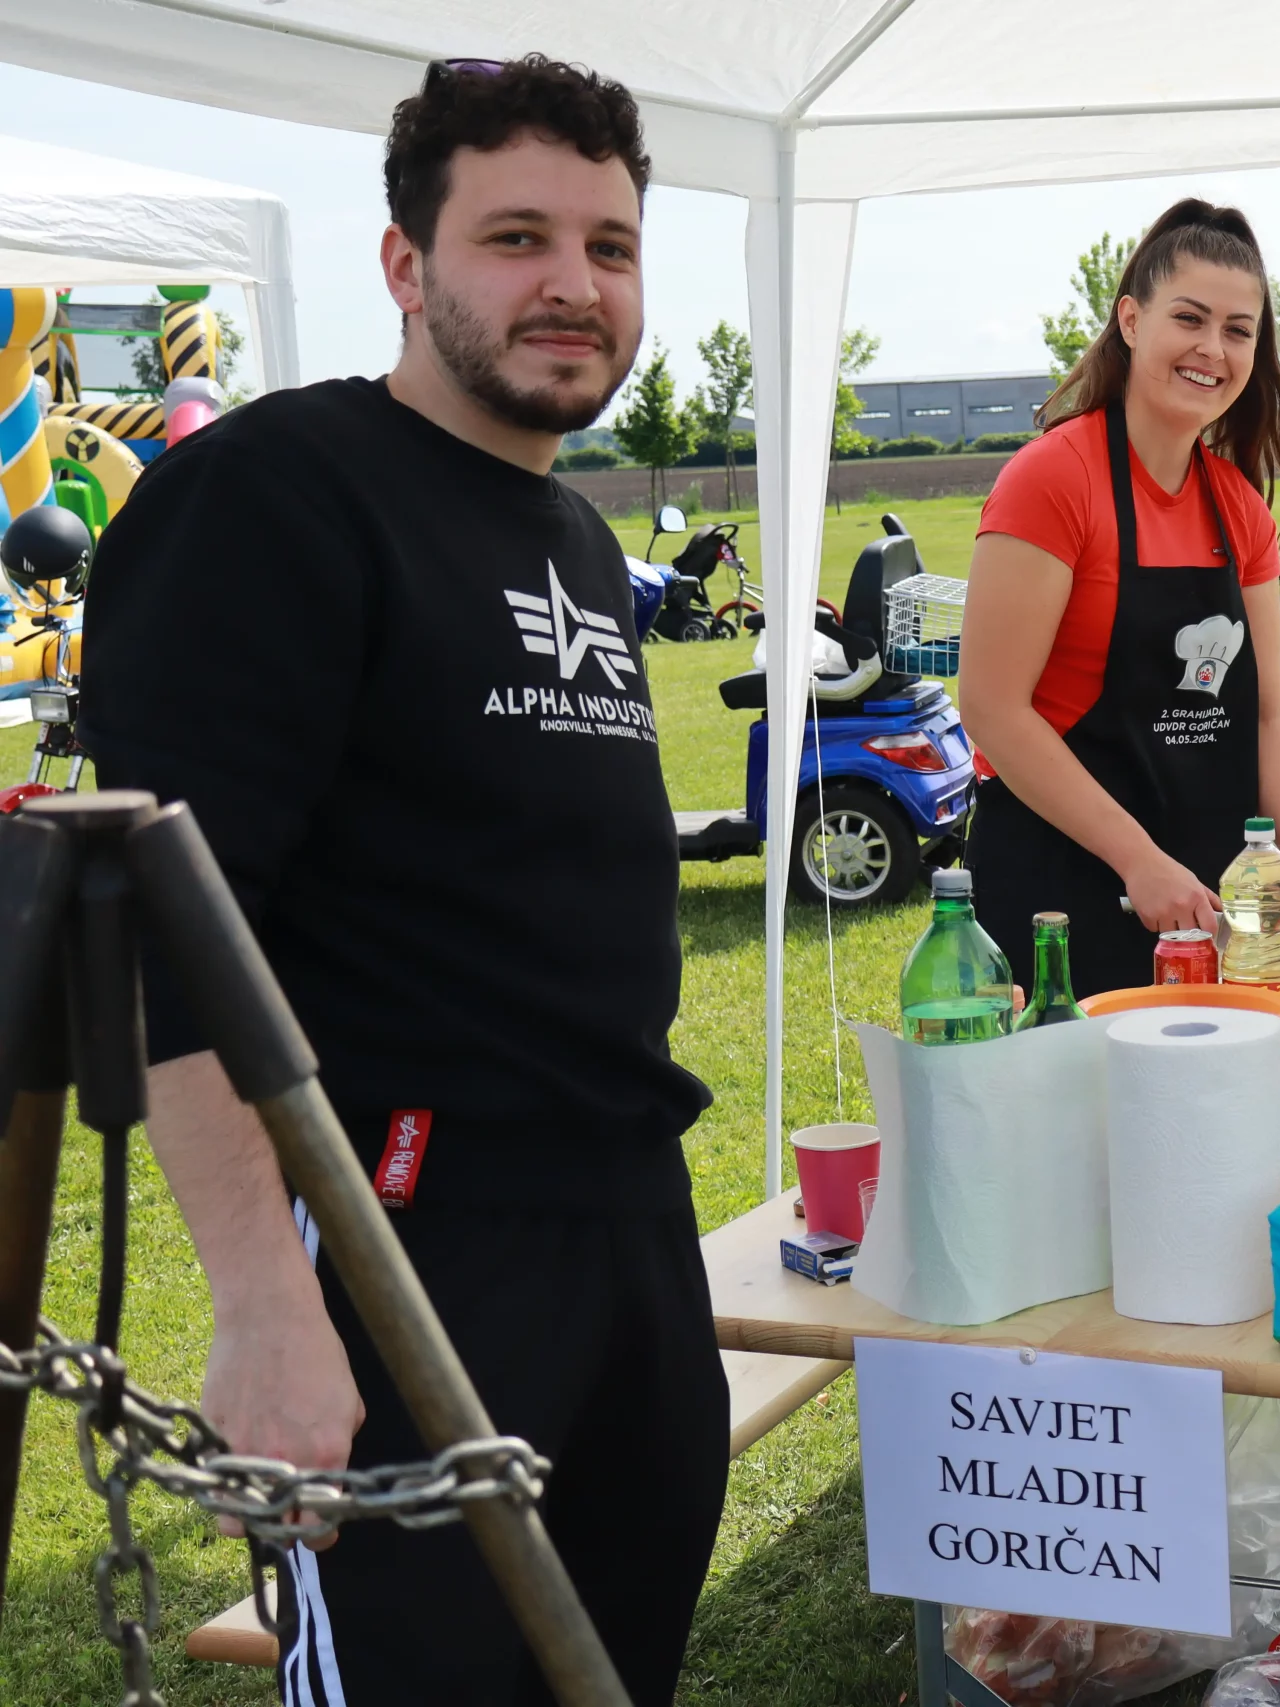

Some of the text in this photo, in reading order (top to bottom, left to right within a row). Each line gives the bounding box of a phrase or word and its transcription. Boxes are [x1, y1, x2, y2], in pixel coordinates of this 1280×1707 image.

[484, 687, 574, 716] ALPHA
[1161, 709, 1170, 719] 2.
[540, 719, 595, 736] KNOXVILLE,
[595, 723, 641, 741] TENNESSEE,
[1153, 718, 1231, 733] UDVDR GORIČAN
[1165, 733, 1218, 745] 04.05.2024.
[382, 1151, 415, 1196] REMOVE
[950, 1391, 1132, 1445] SAVJET
[937, 1454, 1148, 1513] MLADIH
[928, 1522, 1164, 1584] GORIČAN
